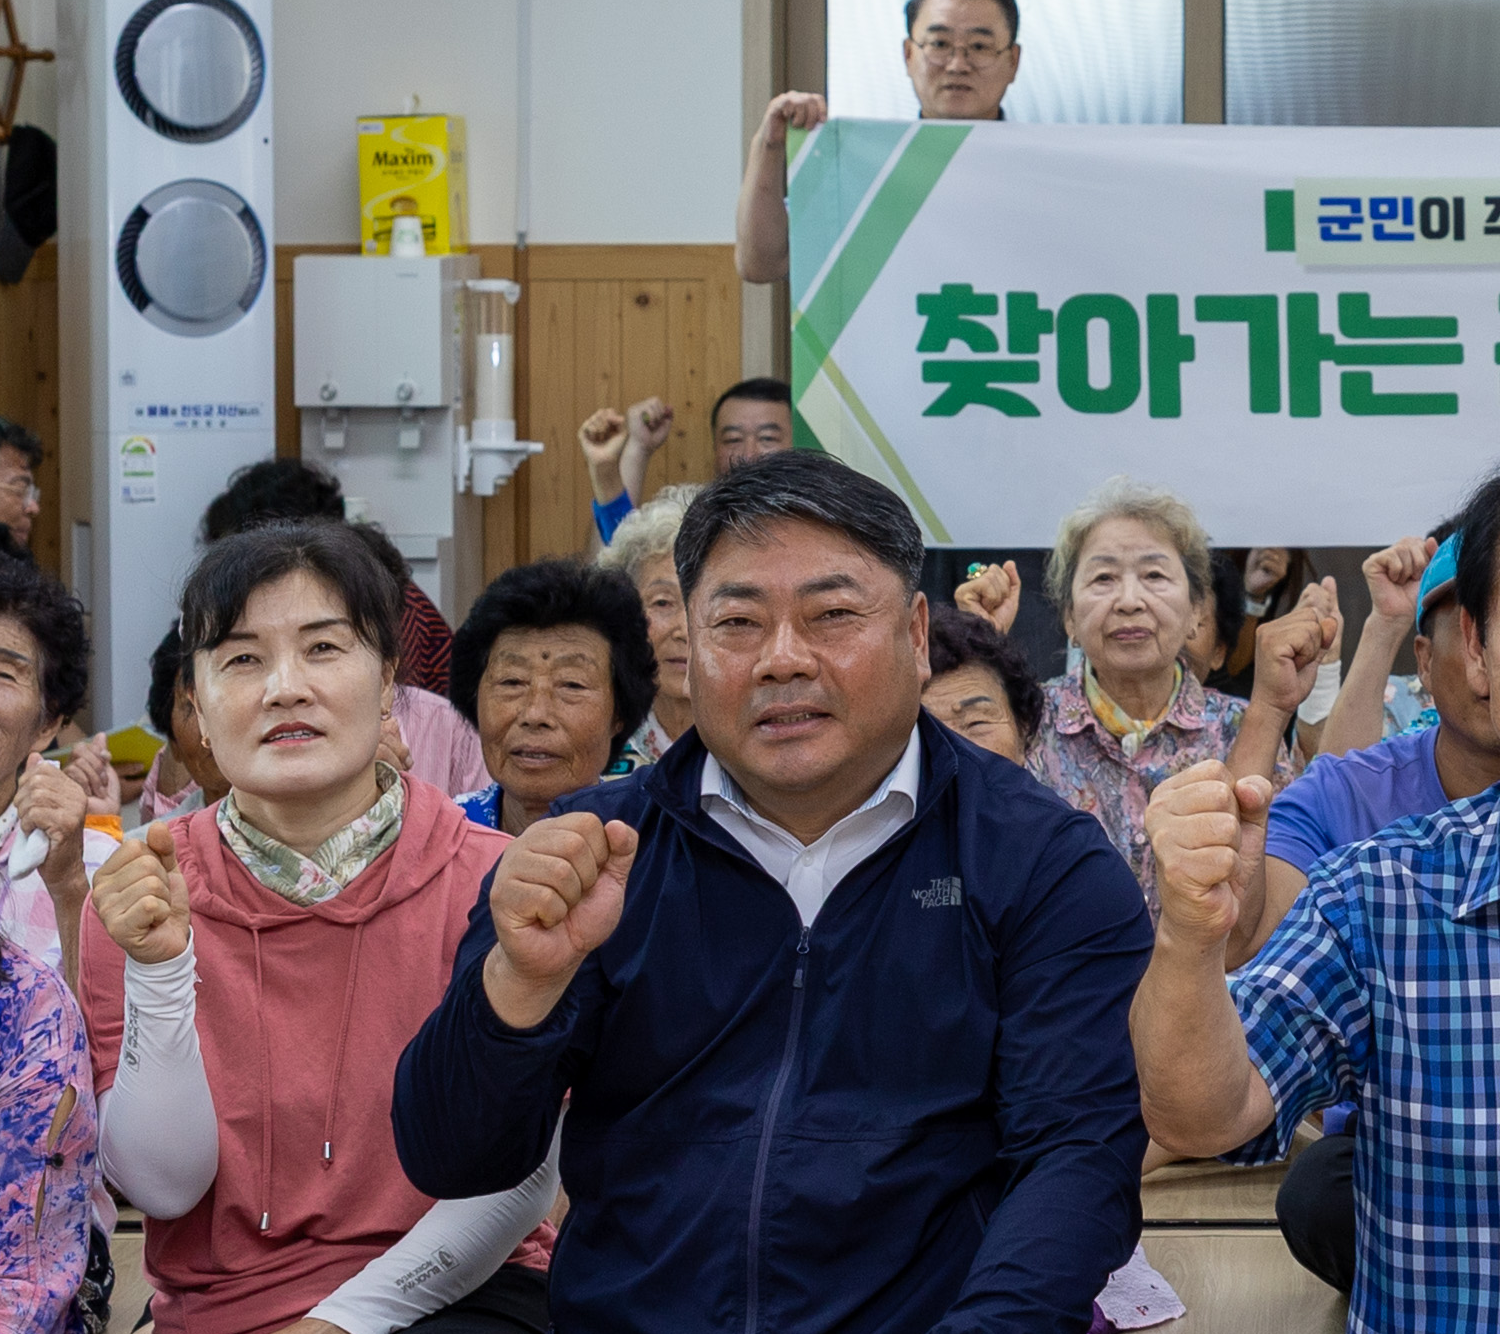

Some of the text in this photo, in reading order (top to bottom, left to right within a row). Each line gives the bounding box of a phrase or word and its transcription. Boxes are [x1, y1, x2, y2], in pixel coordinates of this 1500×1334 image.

[372, 150, 434, 167] Maxim
[1318, 196, 1465, 243] 군민이
[915, 283, 1464, 419] 찾아가는
[930, 877, 951, 890] THE
[911, 885, 951, 900] NORTH
[921, 896, 950, 909] FACE
